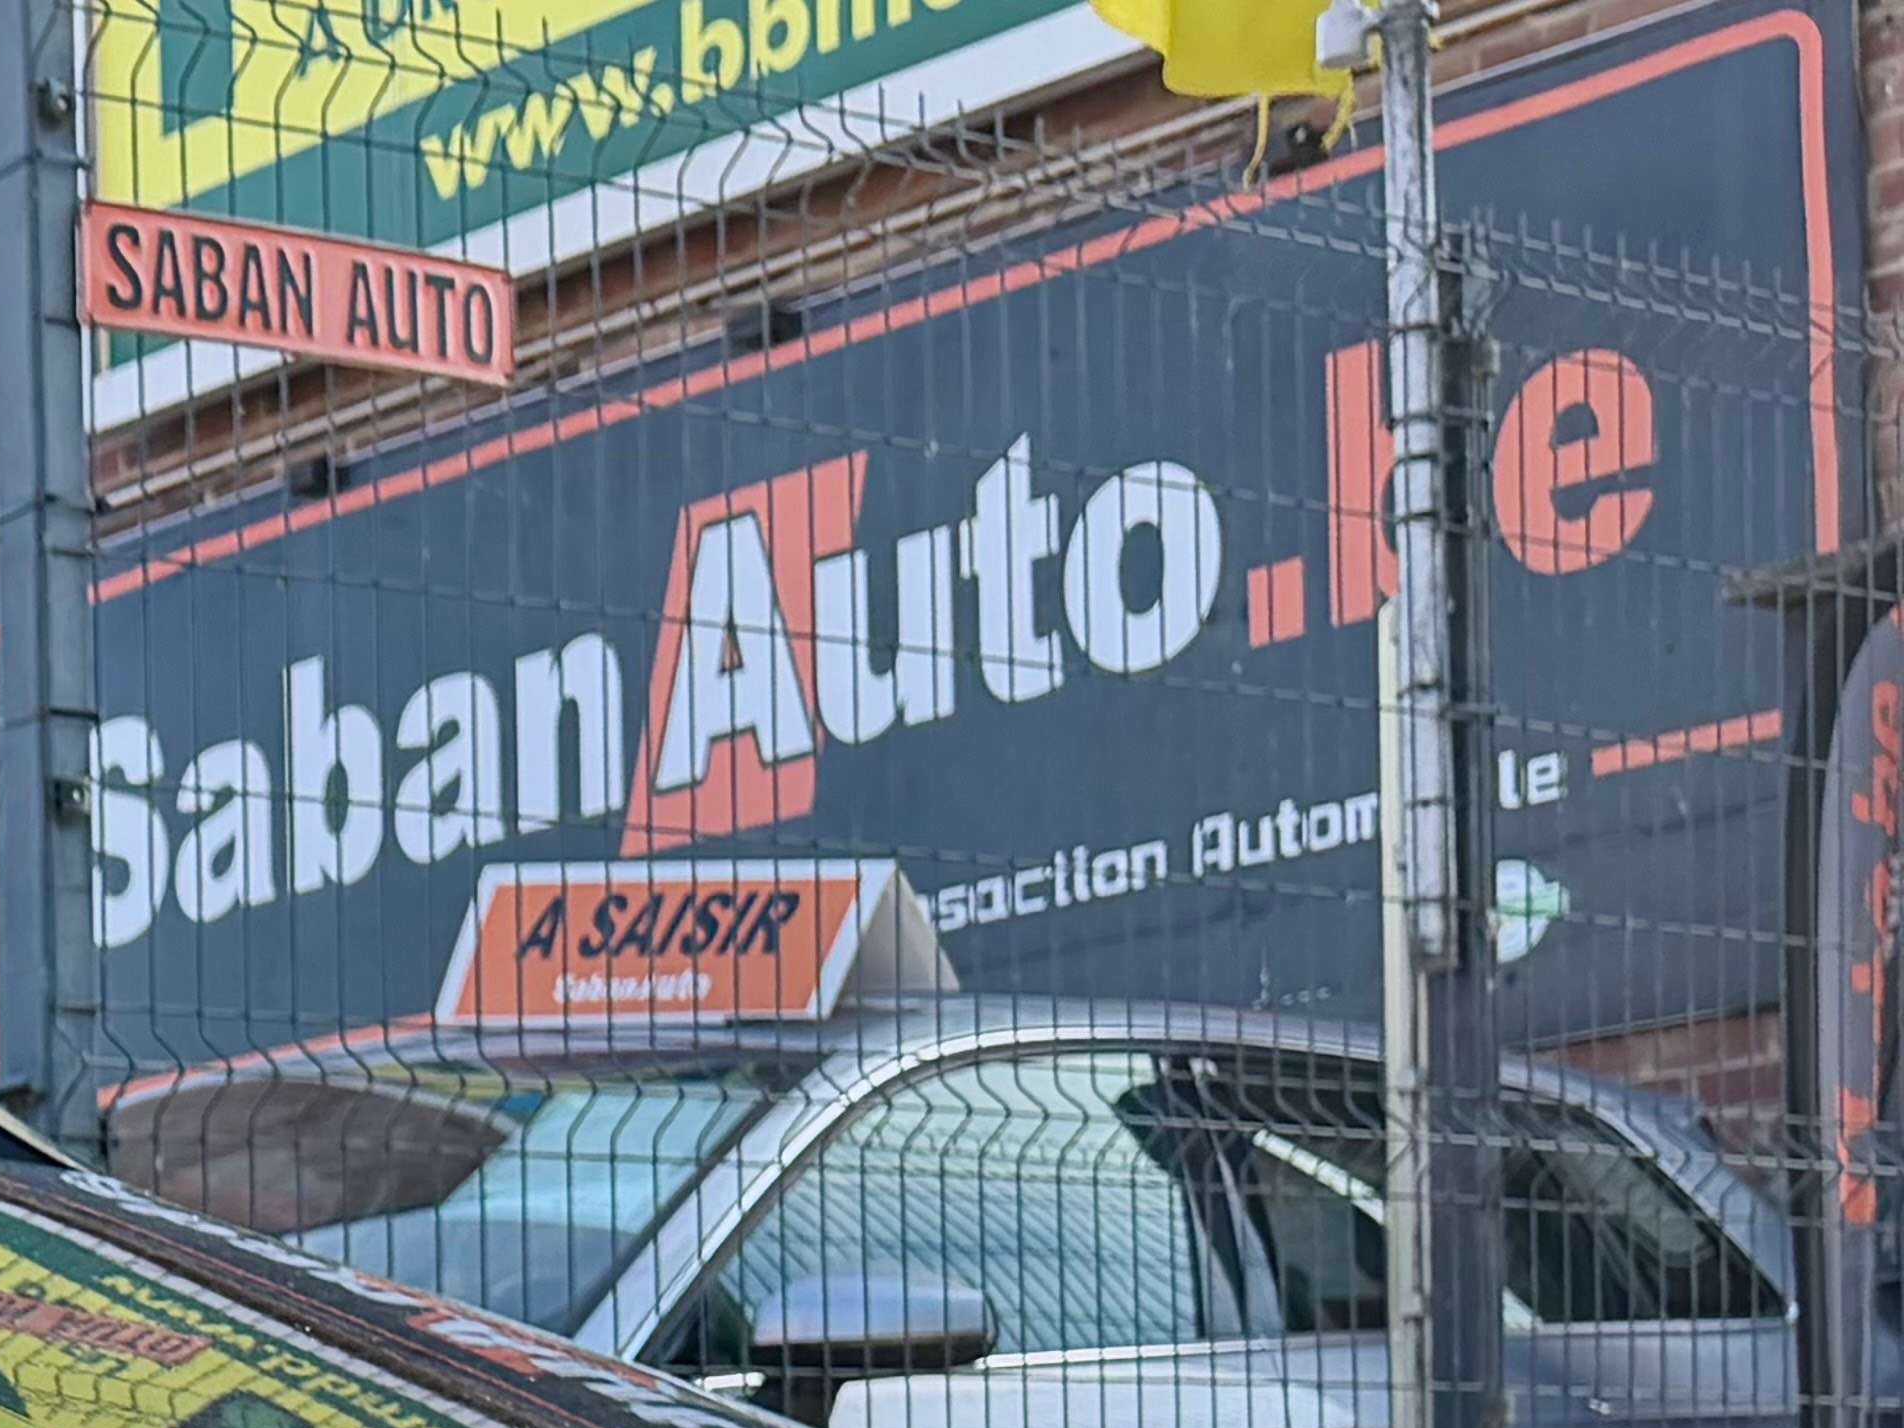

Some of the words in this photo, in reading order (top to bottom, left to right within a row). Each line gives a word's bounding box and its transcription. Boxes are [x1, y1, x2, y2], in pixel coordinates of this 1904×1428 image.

[420, 0, 964, 200] www.bbm
[105, 223, 315, 338] SABAN
[345, 259, 493, 366] AUTO
[920, 839, 1168, 934] saction
[1193, 748, 1566, 876] Automle
[516, 896, 565, 959] A
[578, 890, 801, 960] SAISIR
